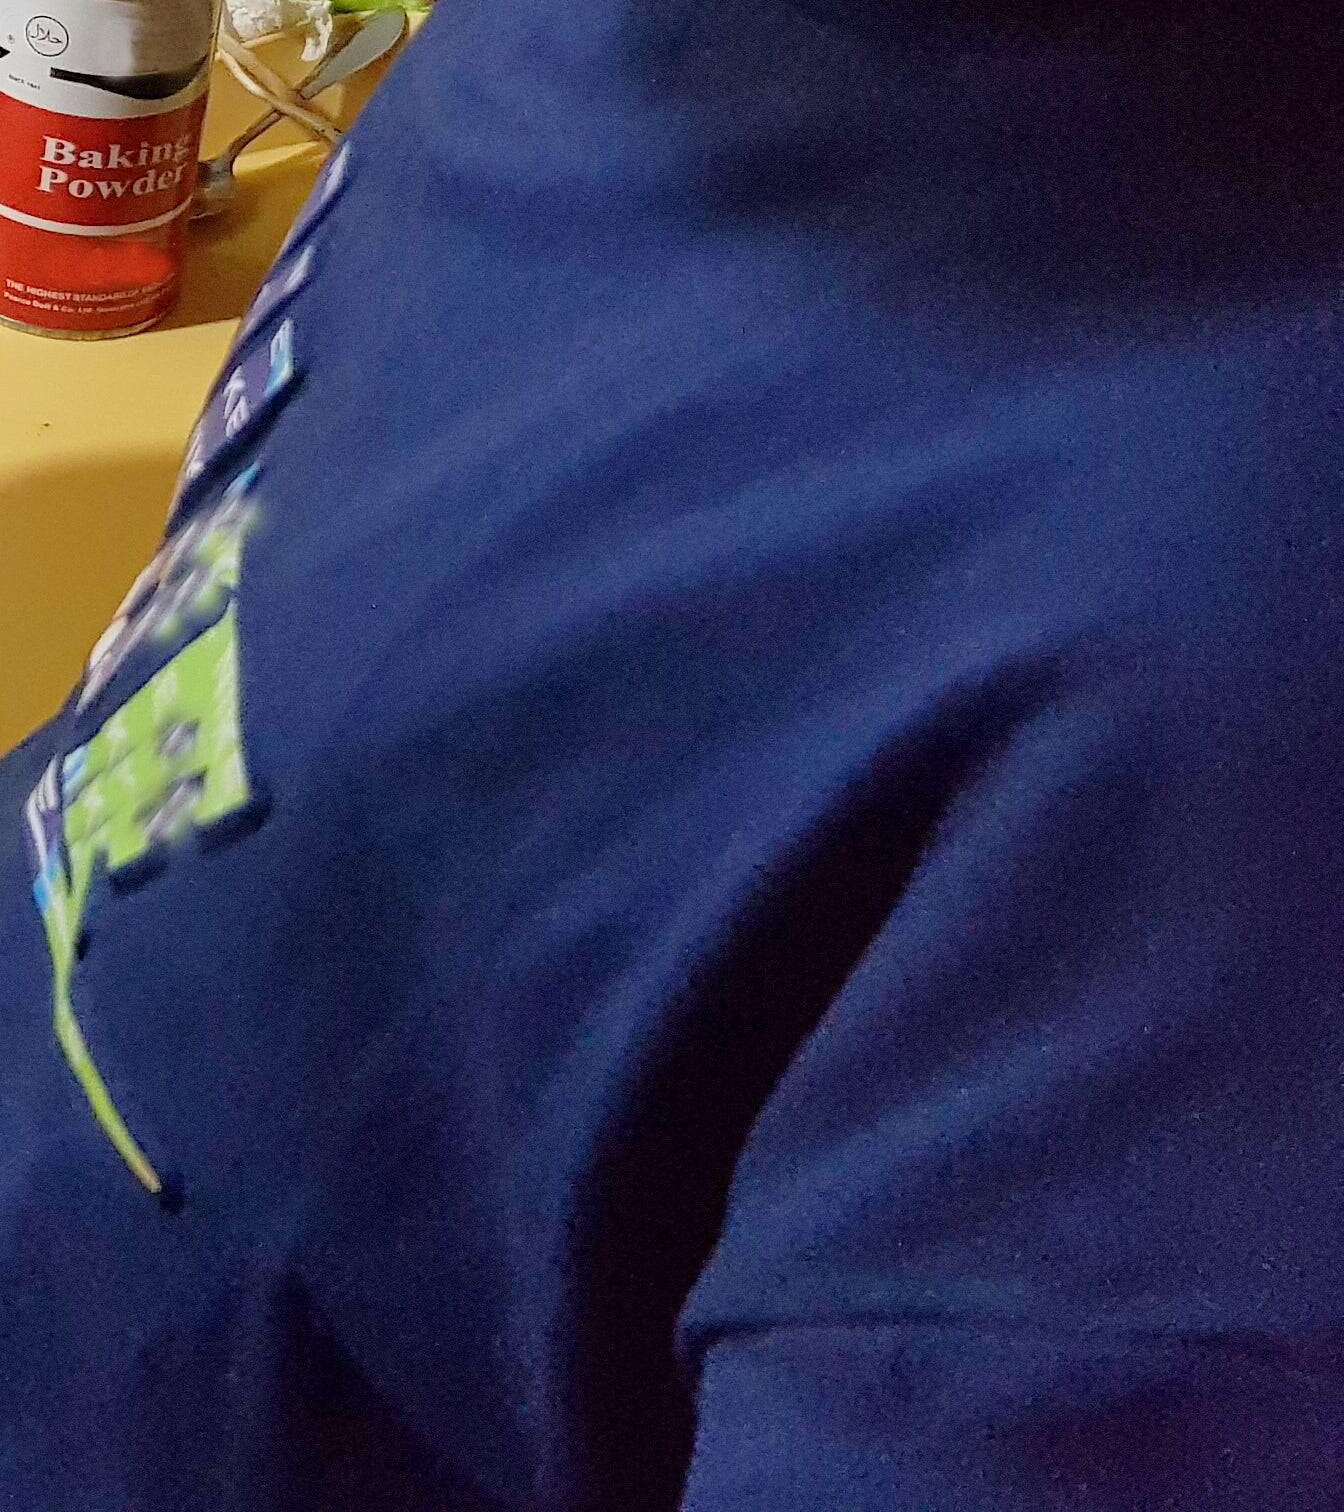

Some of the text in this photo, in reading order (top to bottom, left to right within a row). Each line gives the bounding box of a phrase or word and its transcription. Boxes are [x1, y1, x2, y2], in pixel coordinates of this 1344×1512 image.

[30, 23, 63, 44] حلال
[40, 135, 189, 169] Baking
[35, 163, 187, 199] Powder
[6, 278, 26, 292] THE
[26, 285, 72, 301] HIGHEST
